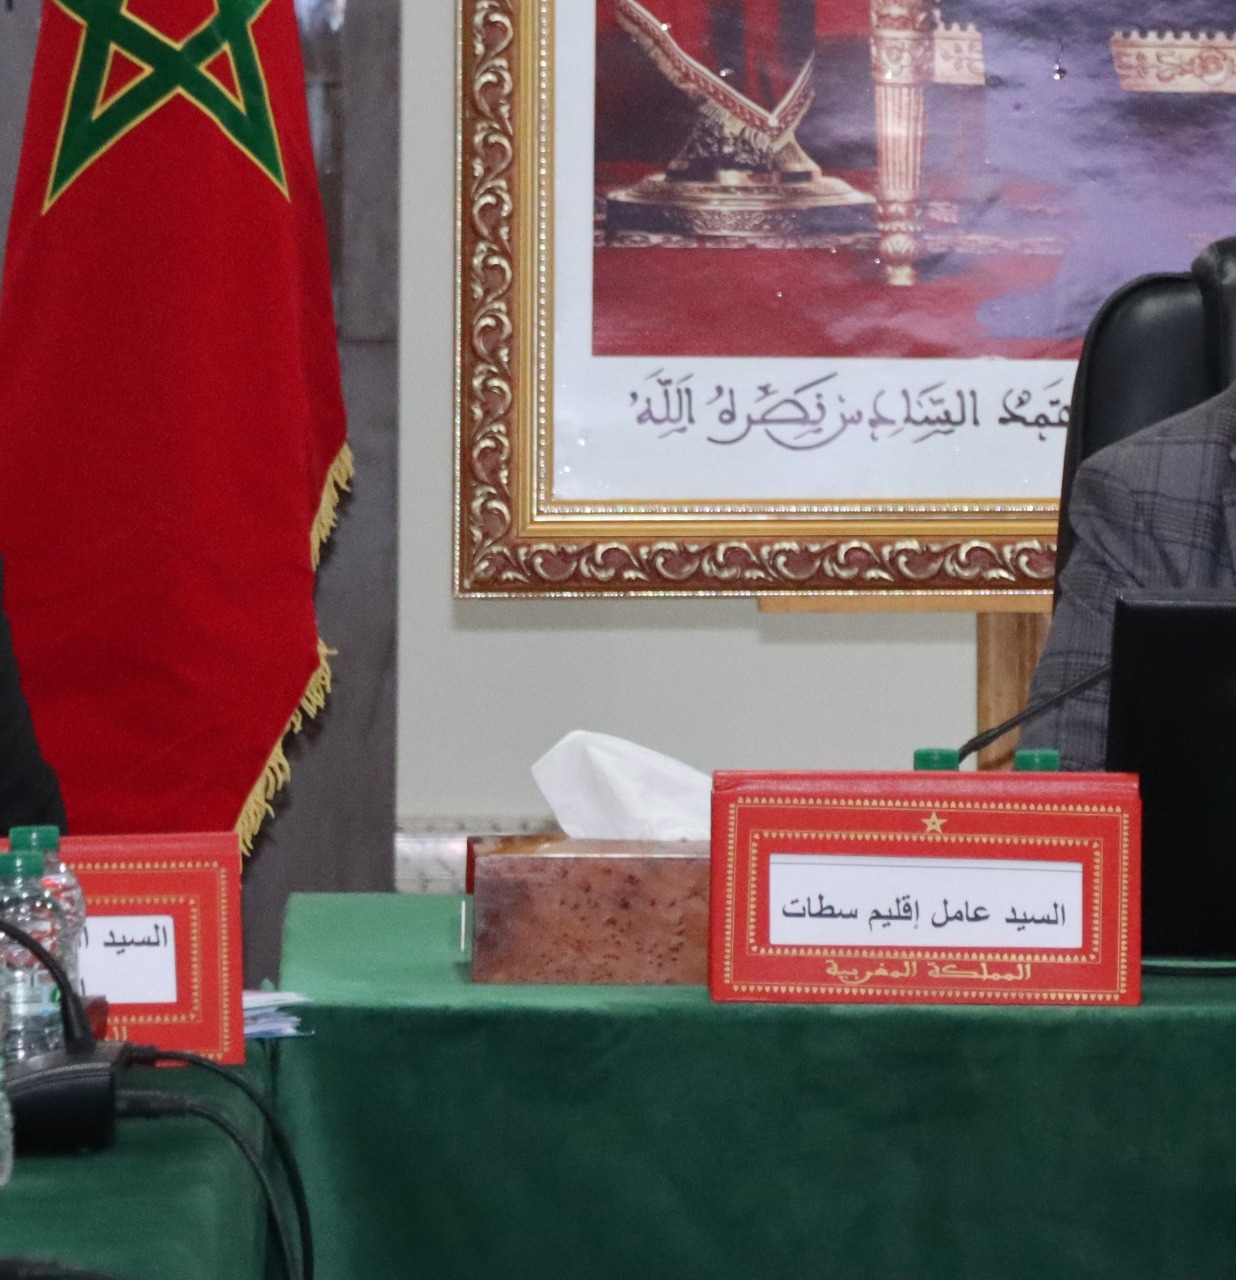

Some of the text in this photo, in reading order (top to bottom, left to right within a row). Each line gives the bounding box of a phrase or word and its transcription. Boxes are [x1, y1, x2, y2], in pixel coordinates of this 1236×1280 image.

[781, 895, 1066, 931] السيد عامل إقليم سطات
[101, 924, 169, 955] السيد
[825, 960, 1032, 984] المملكة المغربية
